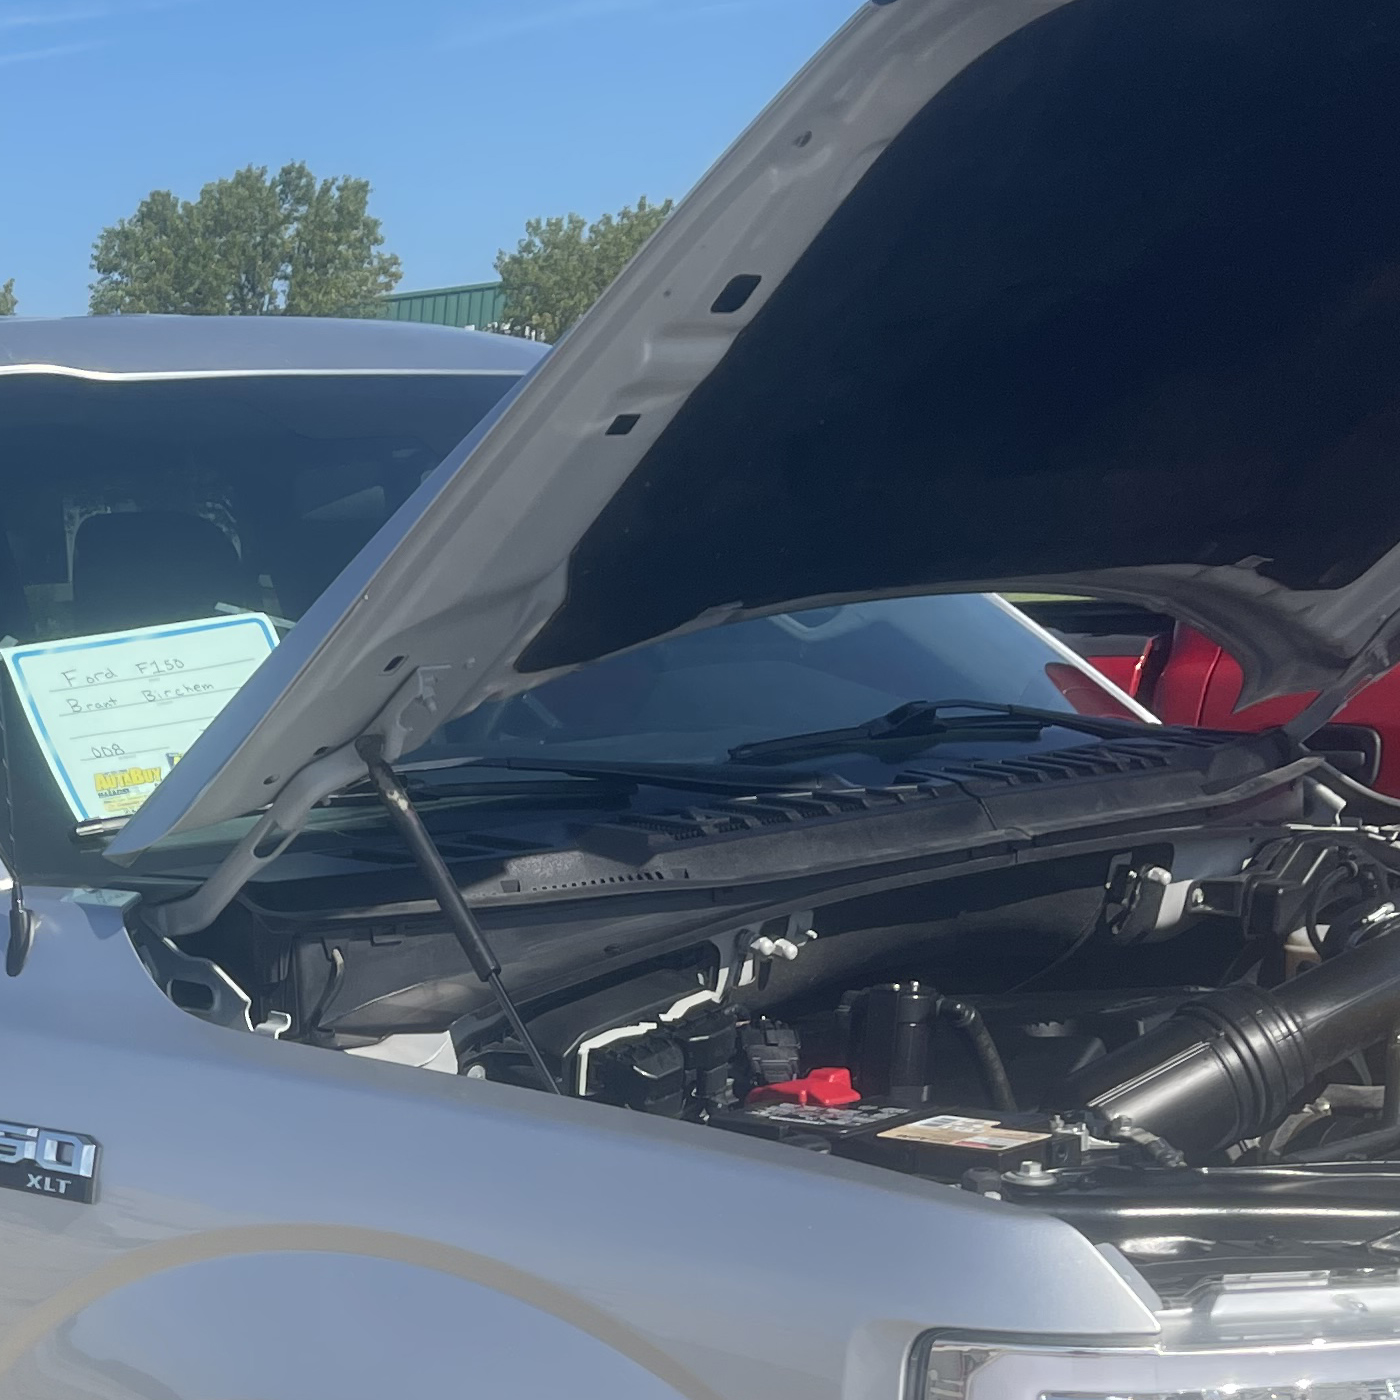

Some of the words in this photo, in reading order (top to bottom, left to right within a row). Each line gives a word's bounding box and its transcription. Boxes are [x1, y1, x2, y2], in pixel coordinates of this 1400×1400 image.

[61, 668, 118, 687] Ford
[135, 658, 185, 675] F150
[27, 1174, 71, 1194] XLT
